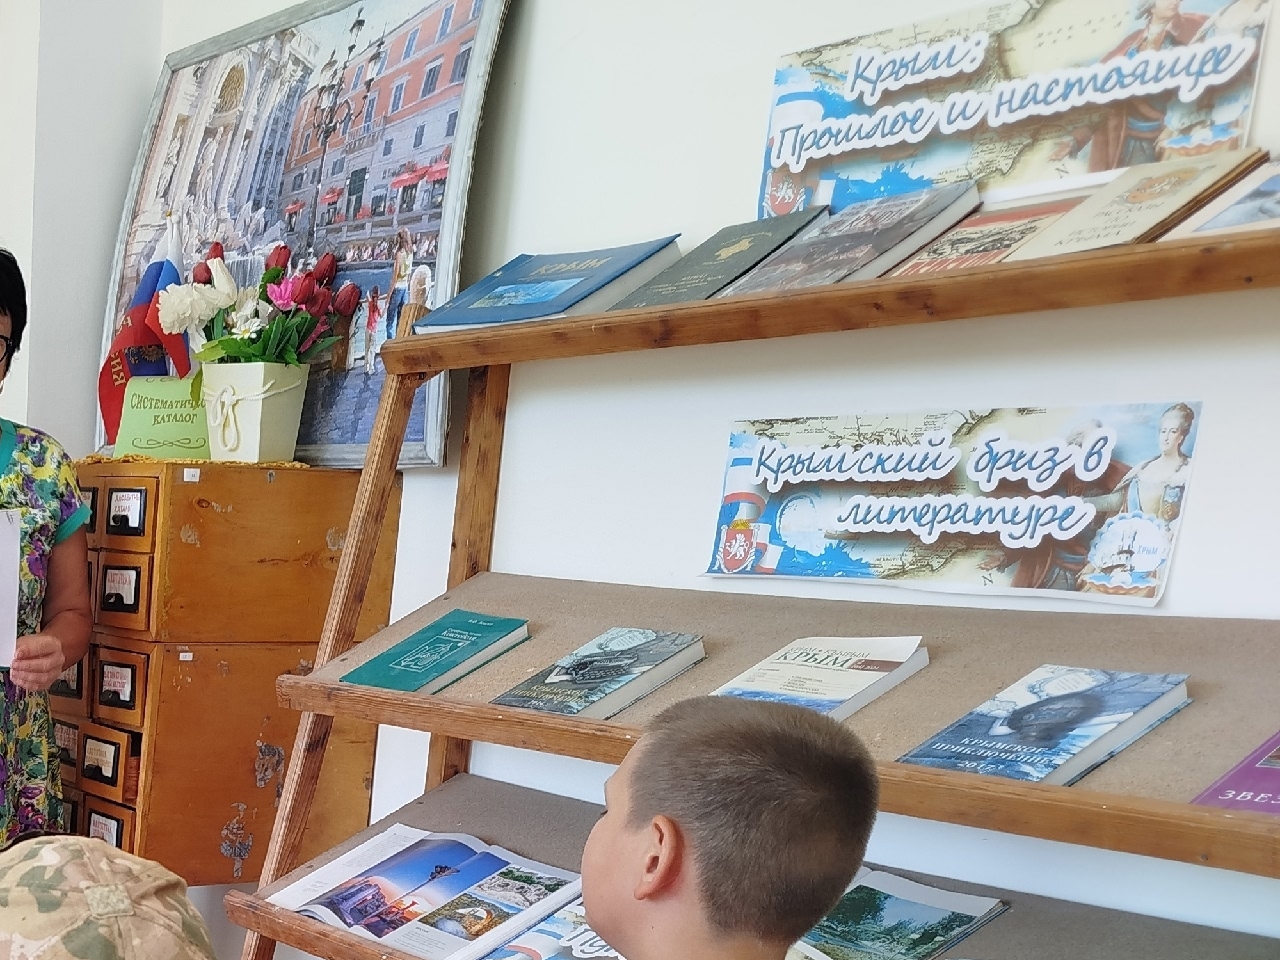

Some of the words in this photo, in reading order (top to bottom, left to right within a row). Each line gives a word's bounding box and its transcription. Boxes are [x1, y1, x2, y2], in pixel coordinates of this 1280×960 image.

[849, 38, 984, 93] Крым:
[775, 107, 935, 164] Прошлое
[947, 100, 982, 126] и
[995, 43, 1245, 118] настоящее
[152, 413, 197, 426] КАТАЛОГ
[756, 437, 954, 484] Крымский
[974, 437, 1071, 481] бриз
[1084, 436, 1108, 473] в
[837, 501, 1087, 542] литературе
[774, 652, 852, 668] КРЫМ
[932, 743, 1050, 763] ПРИКЛЮЧЕНИЕ
[960, 737, 1049, 754] КРЫМСКОЕ
